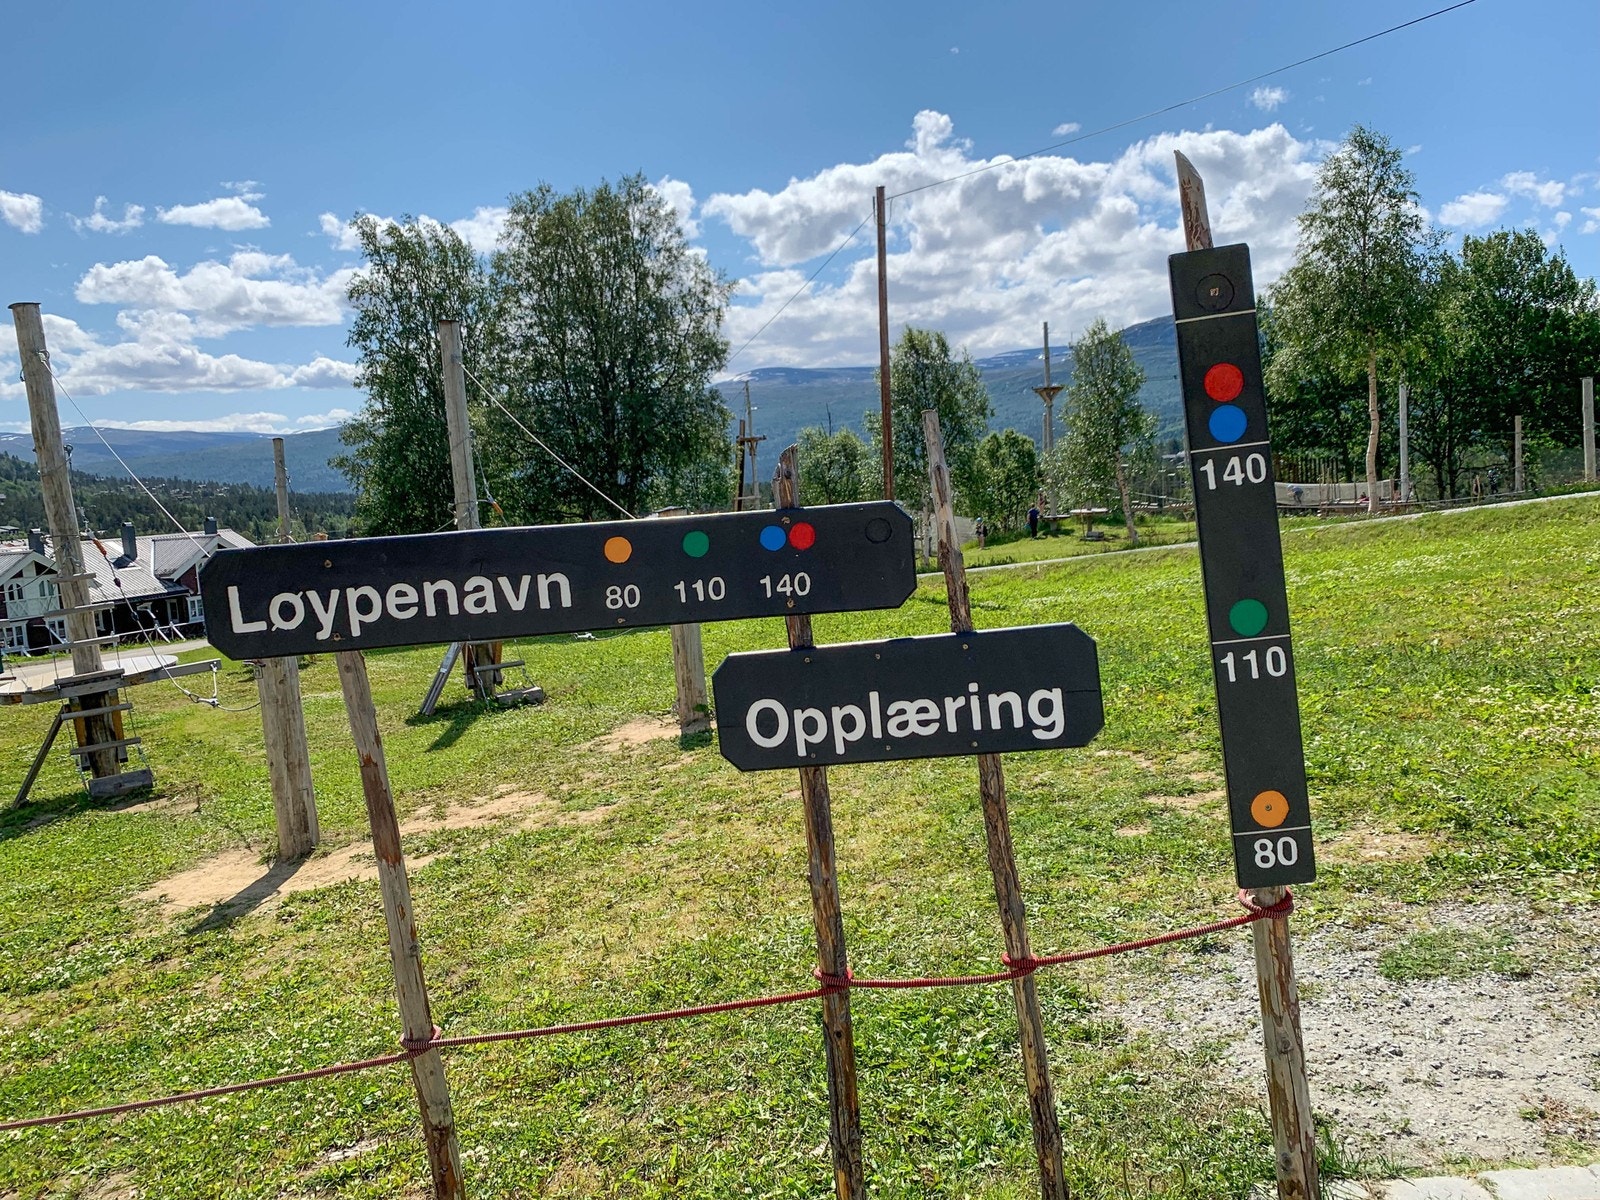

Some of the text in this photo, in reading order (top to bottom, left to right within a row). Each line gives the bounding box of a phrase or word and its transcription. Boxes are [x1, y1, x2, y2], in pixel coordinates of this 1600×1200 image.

[1199, 453, 1267, 490] 140
[227, 571, 811, 641] Løypenavn 80 110 140
[1220, 645, 1287, 683] 110
[745, 682, 1065, 757] Opplæring
[1253, 836, 1298, 869] 80
